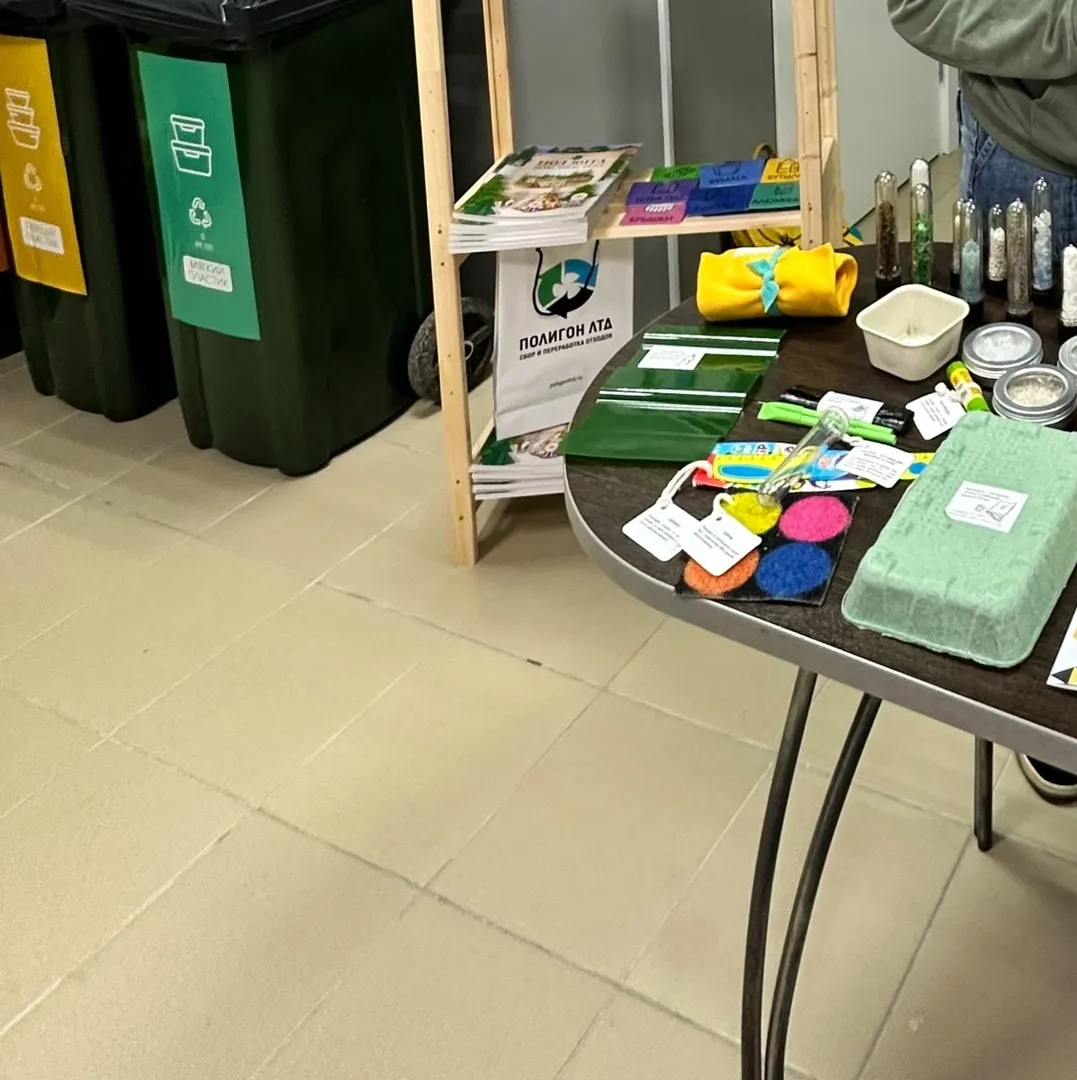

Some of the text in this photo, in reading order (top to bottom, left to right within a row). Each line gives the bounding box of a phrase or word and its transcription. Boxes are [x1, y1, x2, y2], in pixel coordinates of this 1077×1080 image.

[519, 317, 613, 351] ПОЛИГОН ЛТД
[519, 332, 613, 361] СБОР И ПЕРЕРАБОТКА ОТХОДОВ
